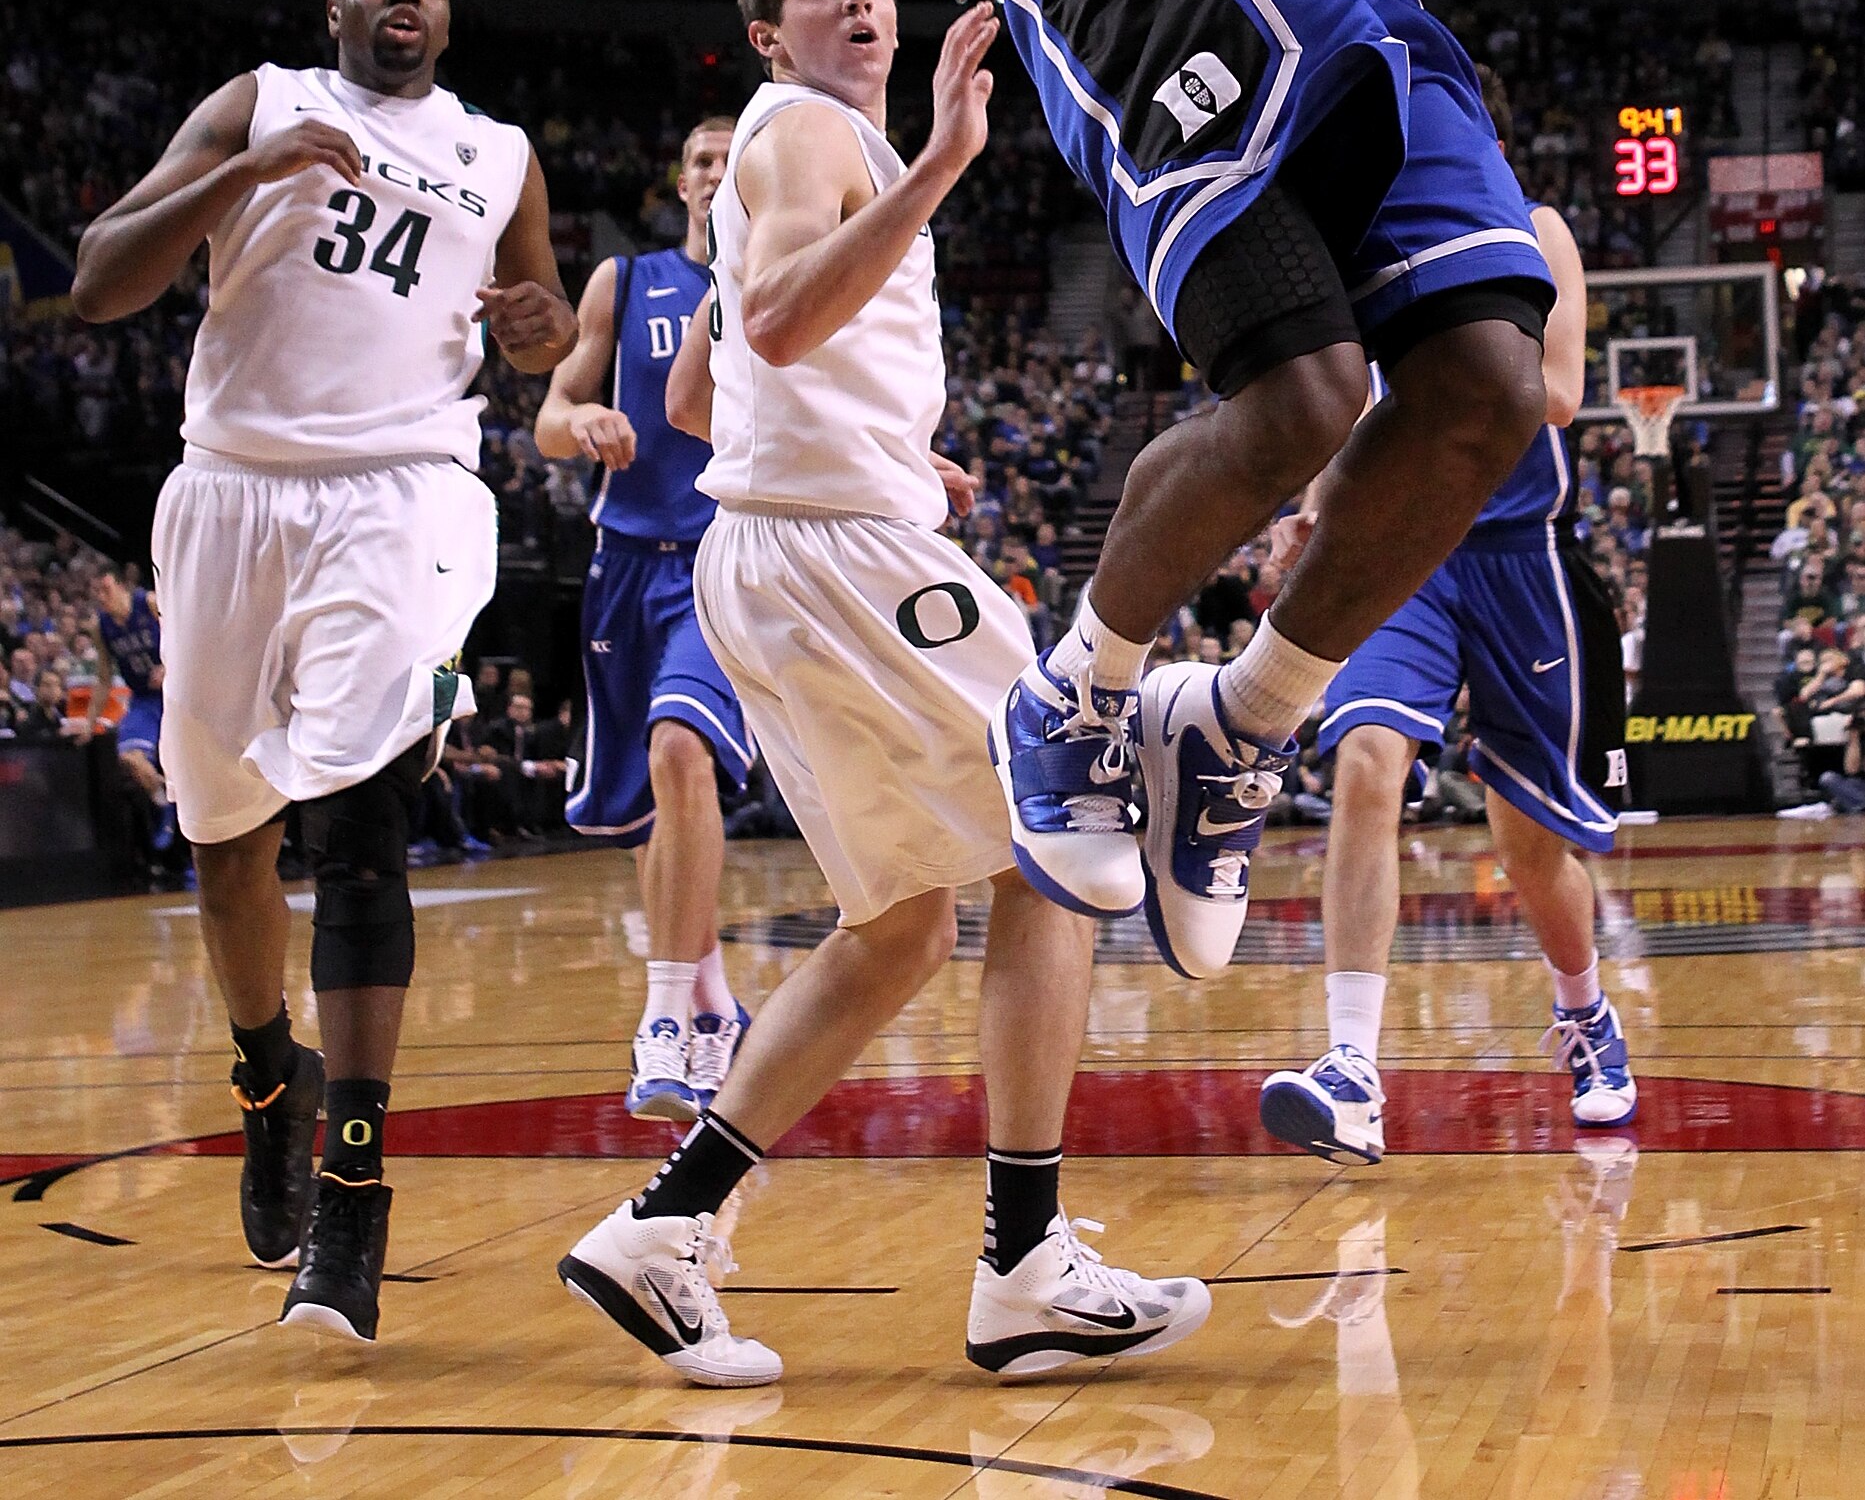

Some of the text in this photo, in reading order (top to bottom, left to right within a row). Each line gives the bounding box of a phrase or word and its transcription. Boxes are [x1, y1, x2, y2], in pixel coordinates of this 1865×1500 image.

[1619, 106, 1682, 137] 9:41
[1614, 137, 1678, 195] 33
[313, 188, 432, 298] 34
[896, 582, 980, 649] O
[342, 1119, 372, 1146] O
